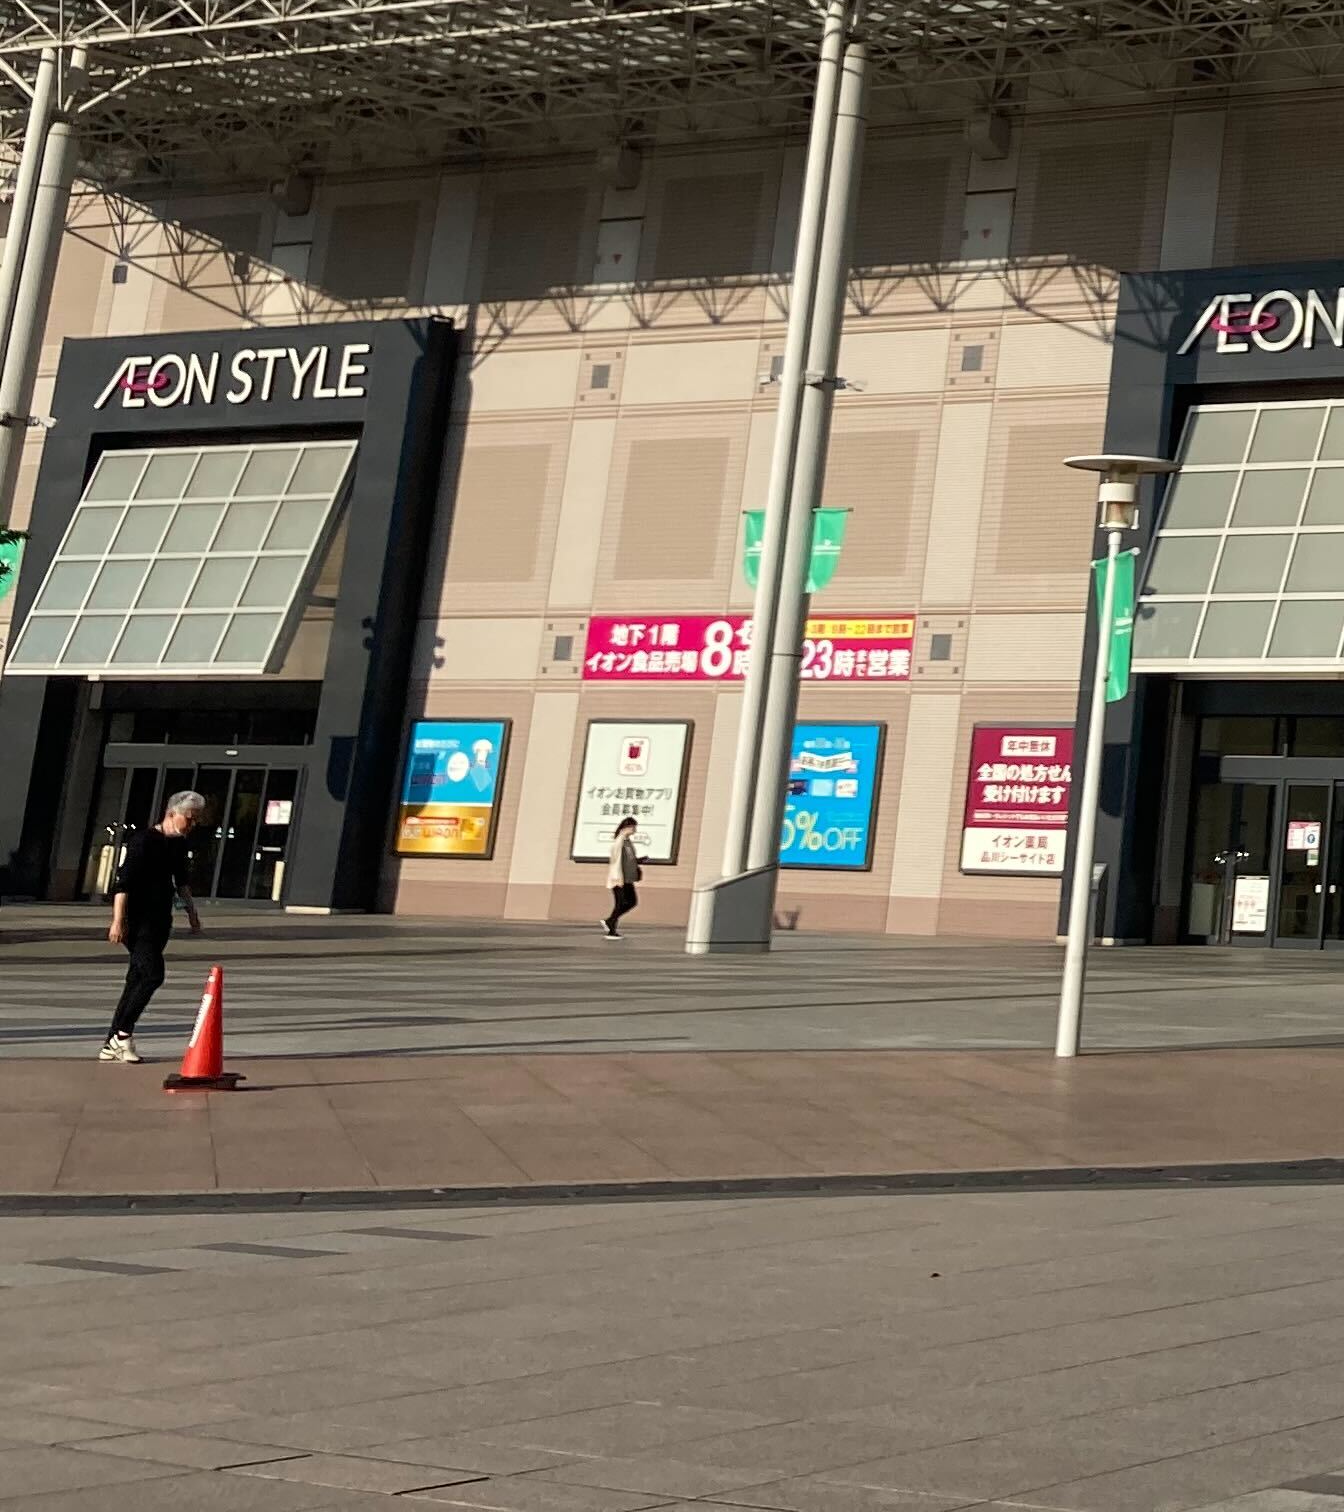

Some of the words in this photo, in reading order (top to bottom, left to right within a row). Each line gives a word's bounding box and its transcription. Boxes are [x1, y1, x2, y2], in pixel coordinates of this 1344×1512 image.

[226, 343, 371, 405] STYLE
[610, 624, 680, 646] 地下1階
[586, 649, 700, 674] イオン食品売場
[976, 763, 1072, 782] 全国の処方せん
[983, 784, 1066, 804] 受け付けます
[992, 835, 1048, 849] イオン薬局
